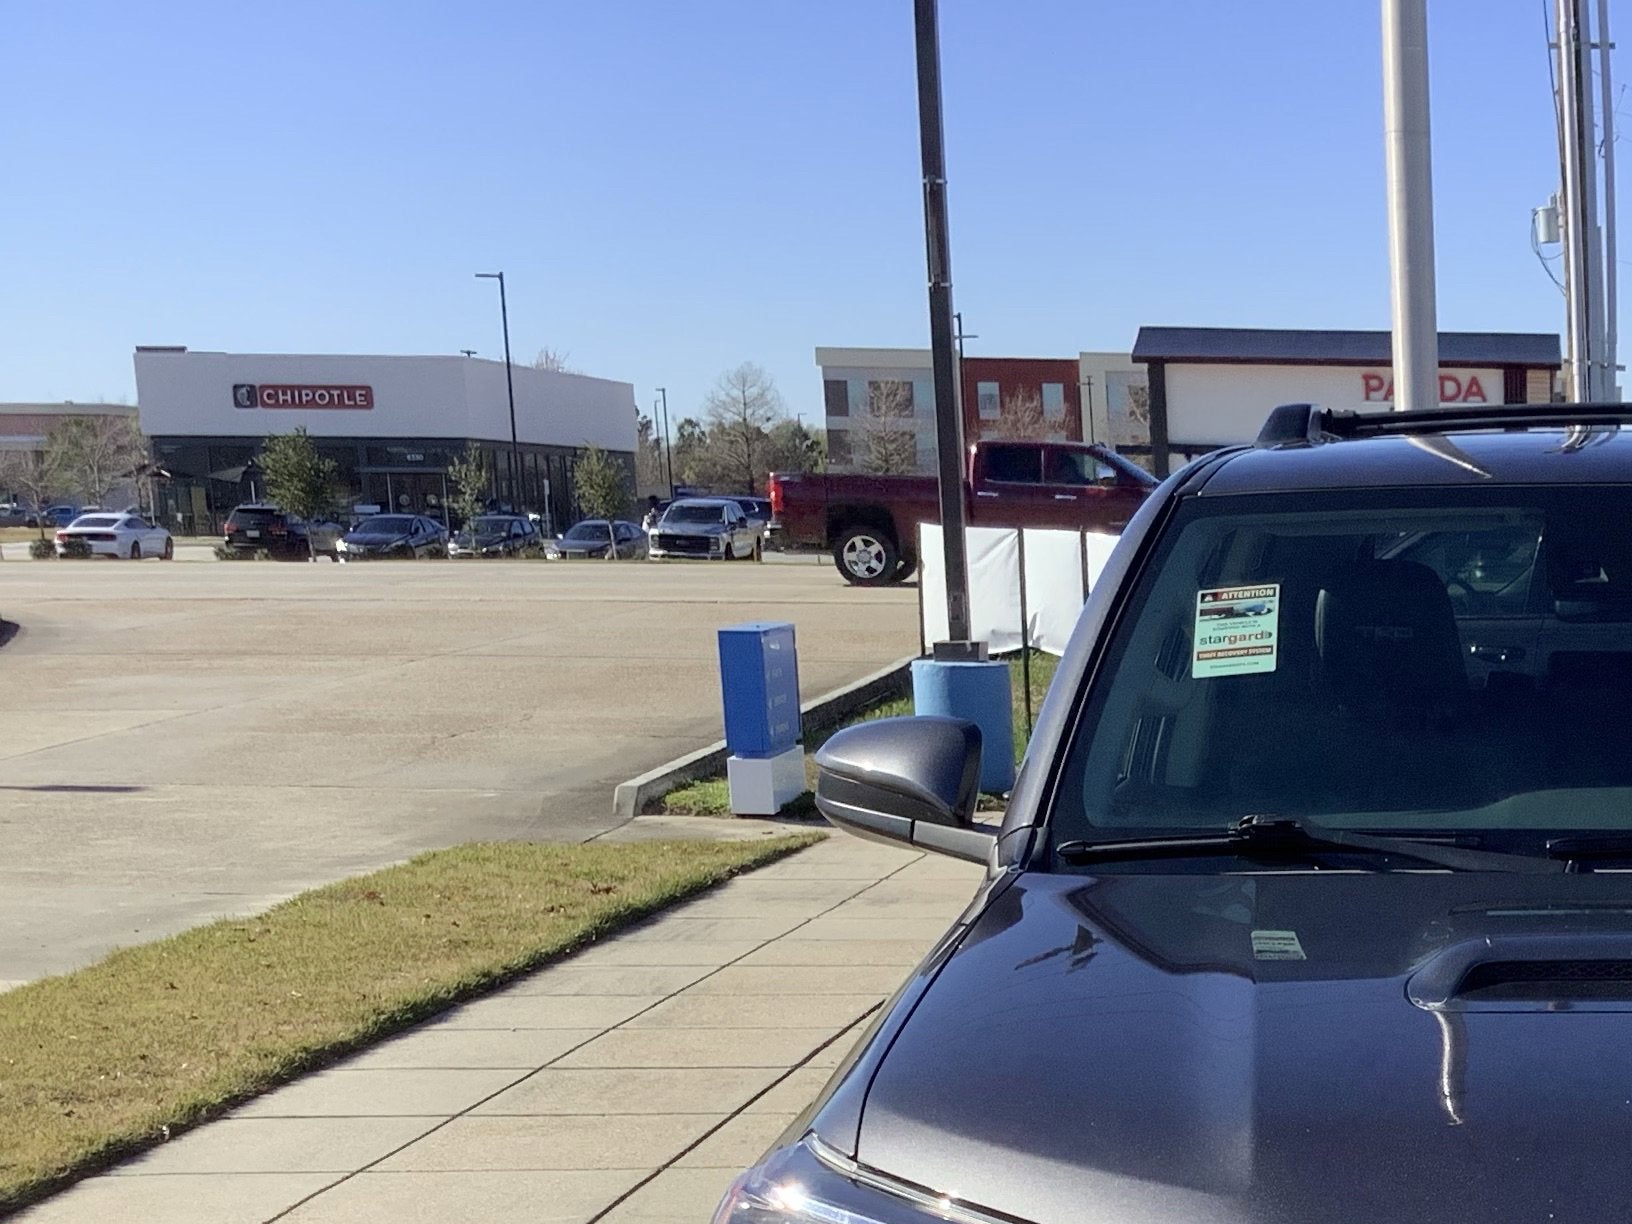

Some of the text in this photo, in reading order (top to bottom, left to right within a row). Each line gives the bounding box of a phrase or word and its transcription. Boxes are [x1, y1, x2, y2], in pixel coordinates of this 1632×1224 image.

[262, 389, 368, 405] CHIPOTLE
[1221, 588, 1275, 600] ATTENTION
[1200, 630, 1265, 645] stargard
